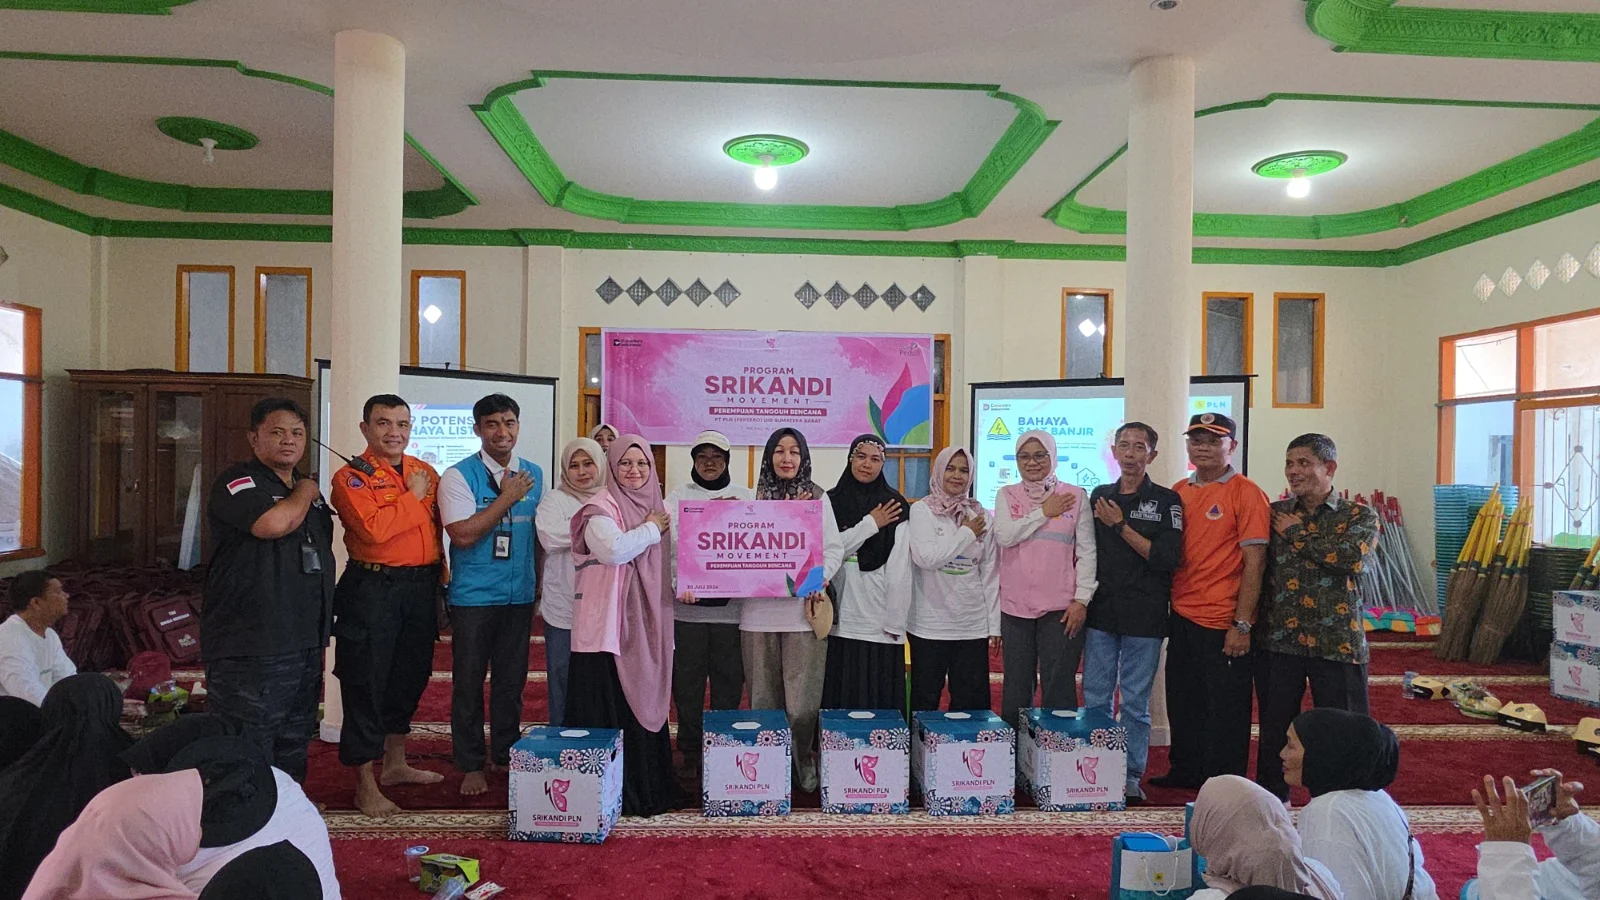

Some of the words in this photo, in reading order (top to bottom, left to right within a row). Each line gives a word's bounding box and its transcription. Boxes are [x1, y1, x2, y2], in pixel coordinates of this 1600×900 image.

[743, 367, 794, 375] PROGRAM
[704, 376, 832, 396] SRIKANDI
[421, 416, 474, 425] POTENS
[1018, 416, 1069, 426] BAHAYA
[412, 426, 445, 436] HAYA
[448, 426, 474, 436] LIST
[1051, 427, 1094, 436] BANJIR
[697, 532, 806, 550] SRIKANDI
[951, 780, 981, 788] SRIKANDI
[532, 814, 568, 822] SRIKANDI
